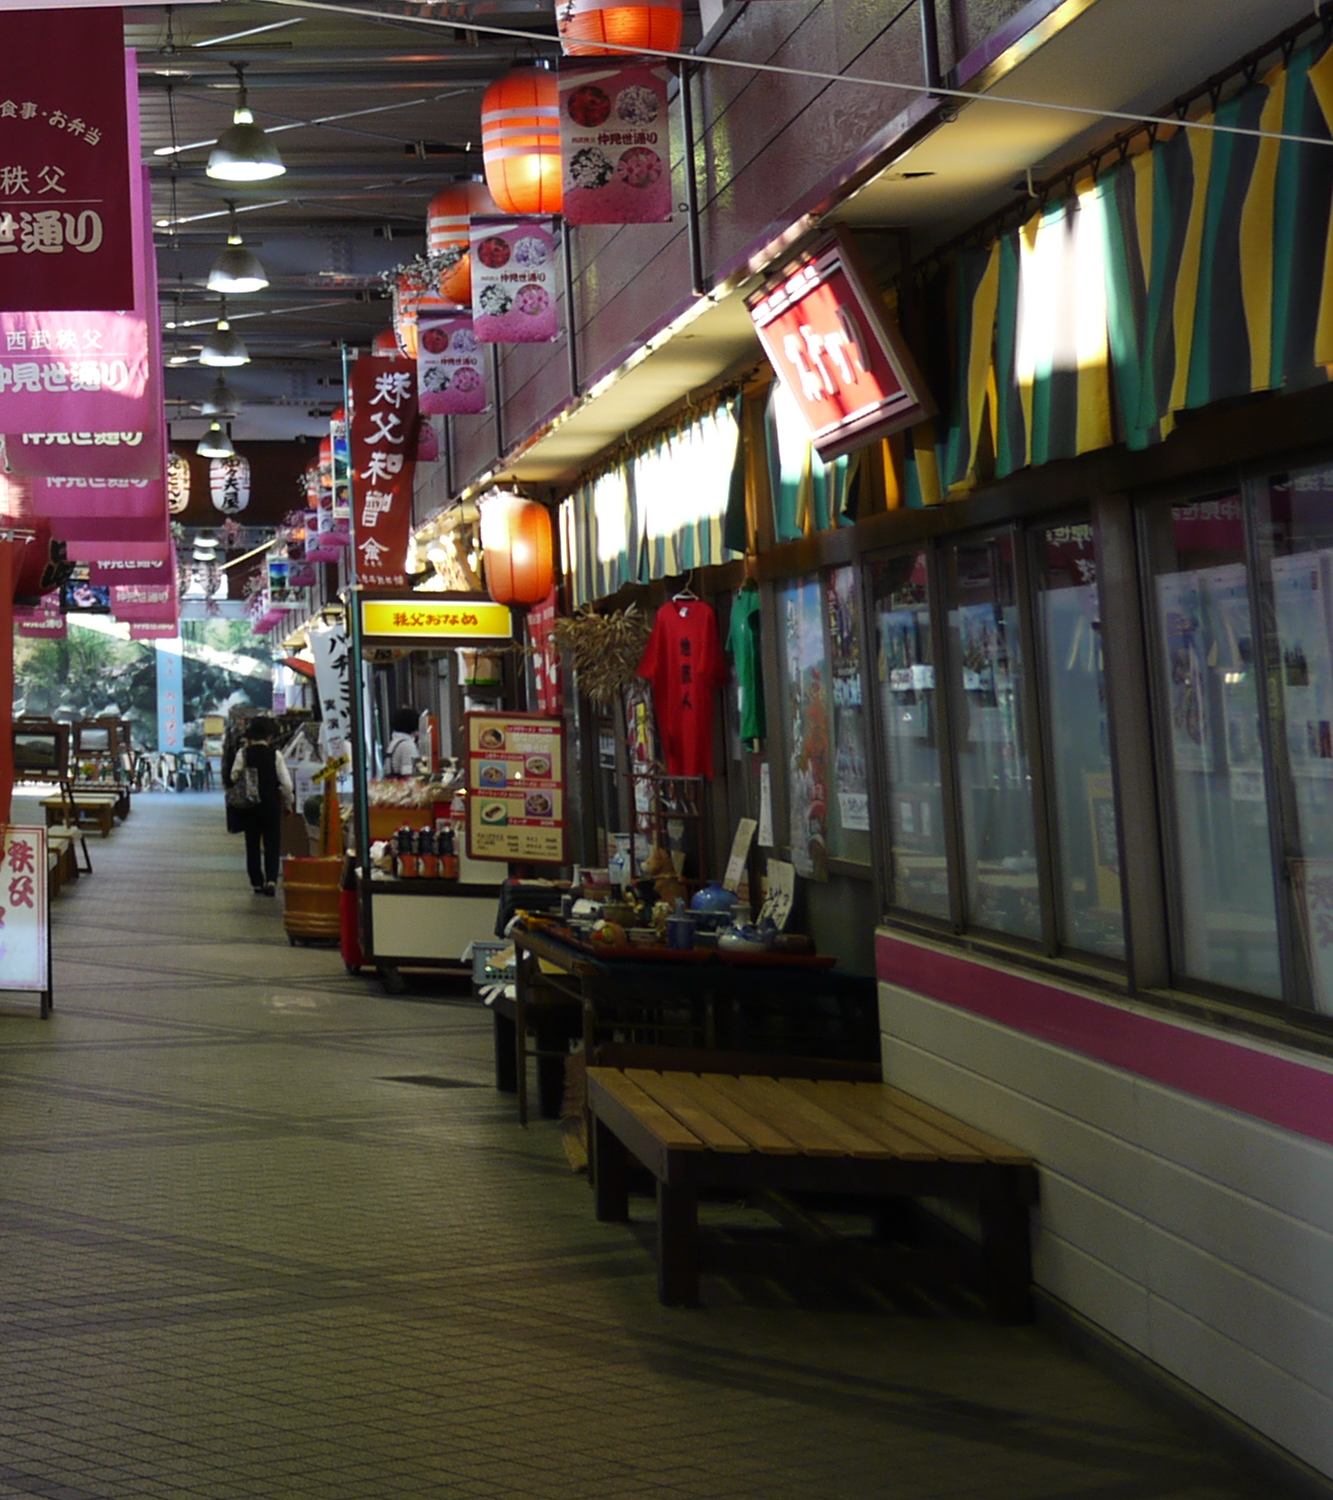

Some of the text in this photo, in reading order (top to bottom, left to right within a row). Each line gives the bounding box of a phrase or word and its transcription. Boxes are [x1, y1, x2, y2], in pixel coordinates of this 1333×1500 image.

[597, 132, 658, 146] 仲見世通り
[6, 329, 103, 351] 西武秩父
[8, 839, 34, 909] 秩父
